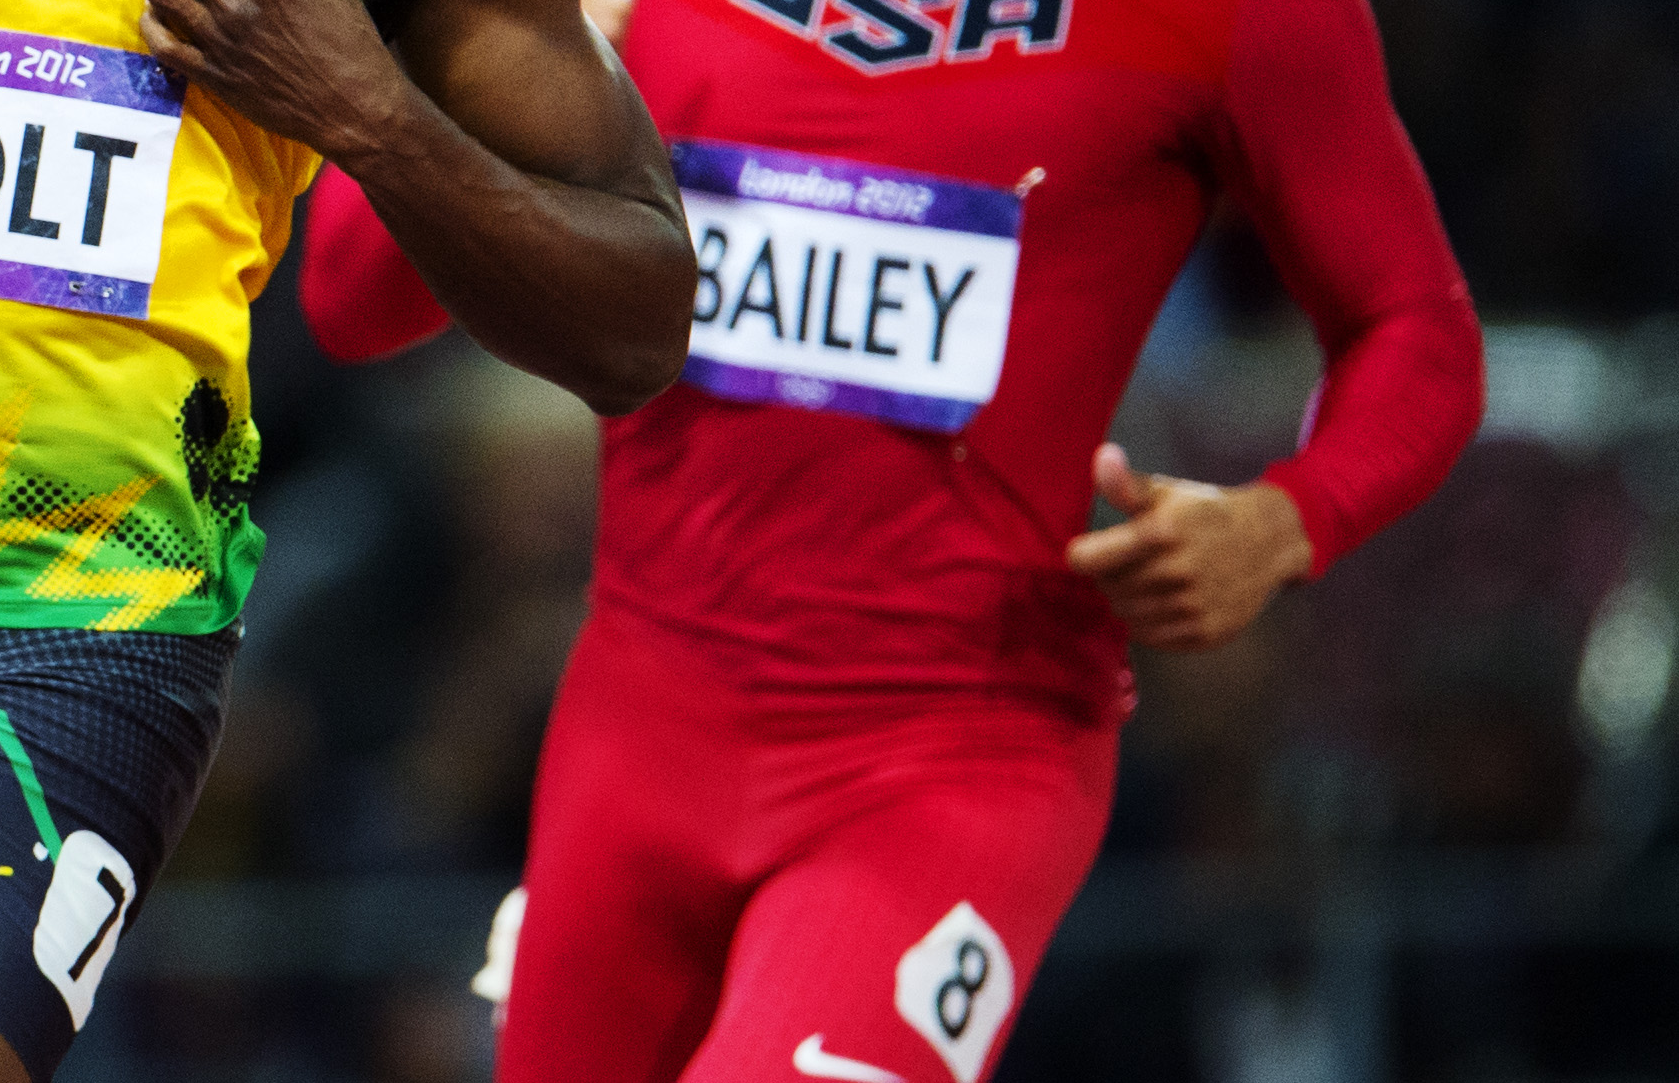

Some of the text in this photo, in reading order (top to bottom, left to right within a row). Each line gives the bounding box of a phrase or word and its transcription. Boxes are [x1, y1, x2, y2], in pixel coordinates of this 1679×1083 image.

[15, 45, 96, 88] 2012
[693, 227, 976, 363] BAILEY
[67, 865, 127, 982] 7
[937, 940, 988, 1040] 8
